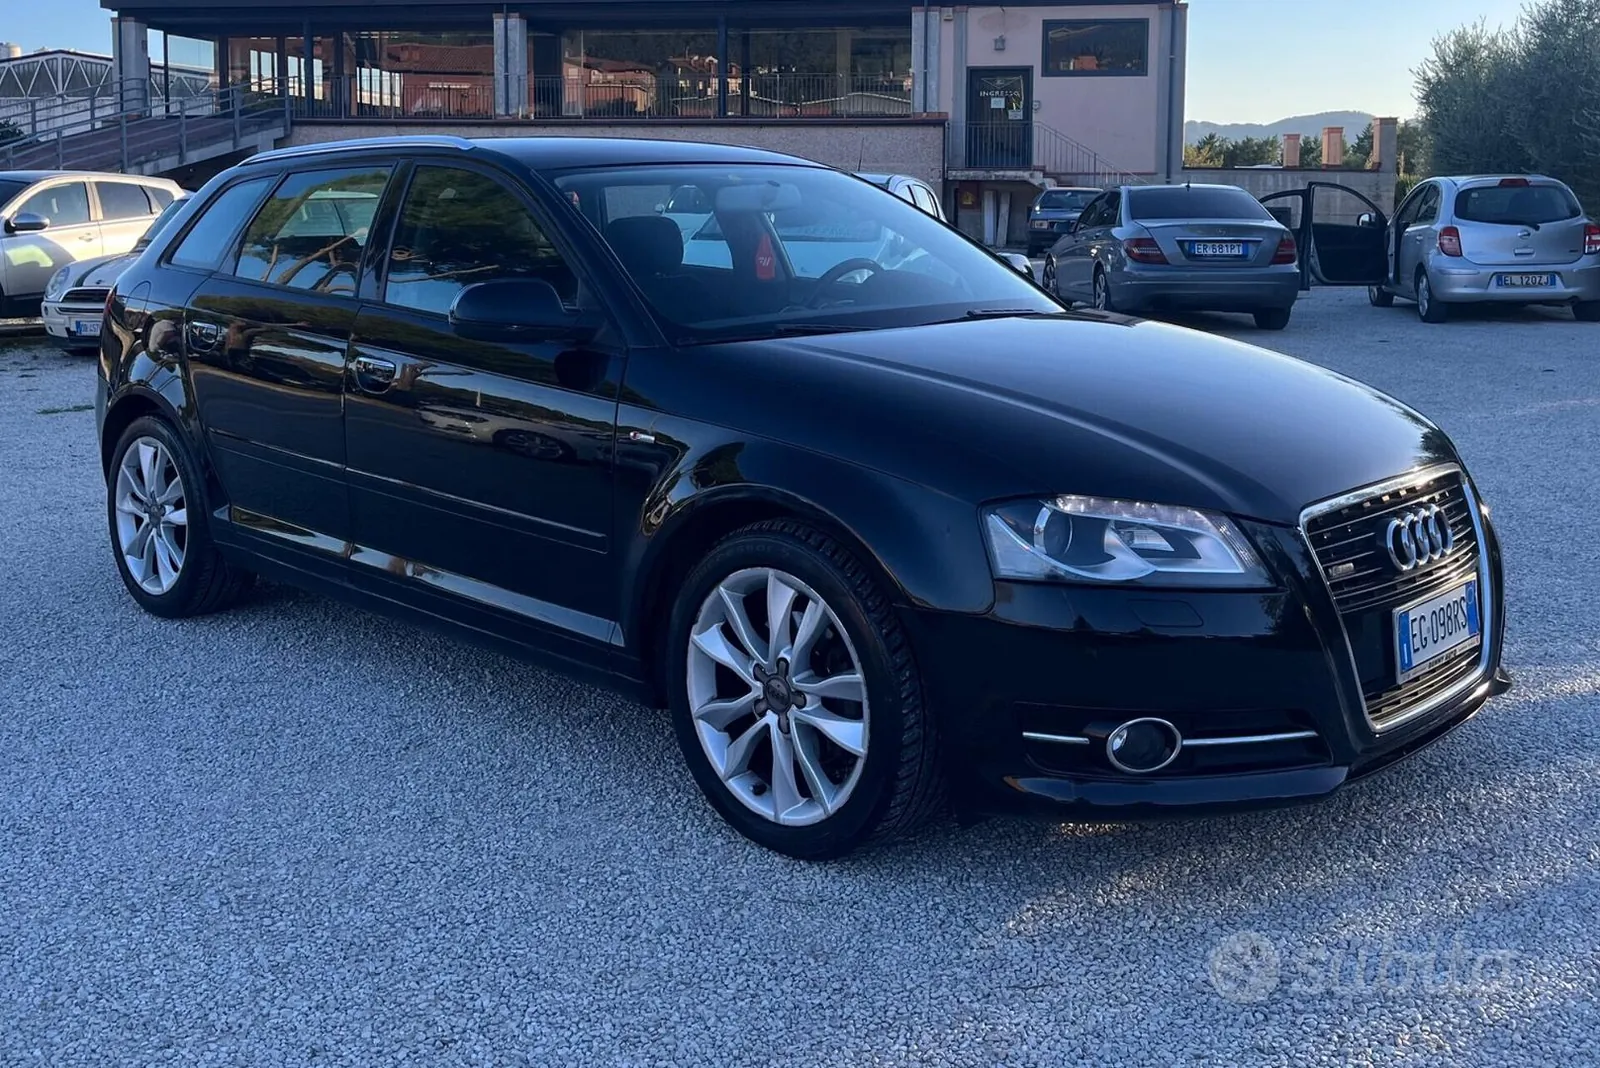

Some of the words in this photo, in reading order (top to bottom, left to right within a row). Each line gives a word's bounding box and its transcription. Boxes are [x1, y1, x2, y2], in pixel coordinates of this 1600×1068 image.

[1196, 243, 1208, 254] ER
[1503, 275, 1515, 286] EL
[1410, 614, 1428, 653] EG
[1430, 596, 1467, 644] 098RS
